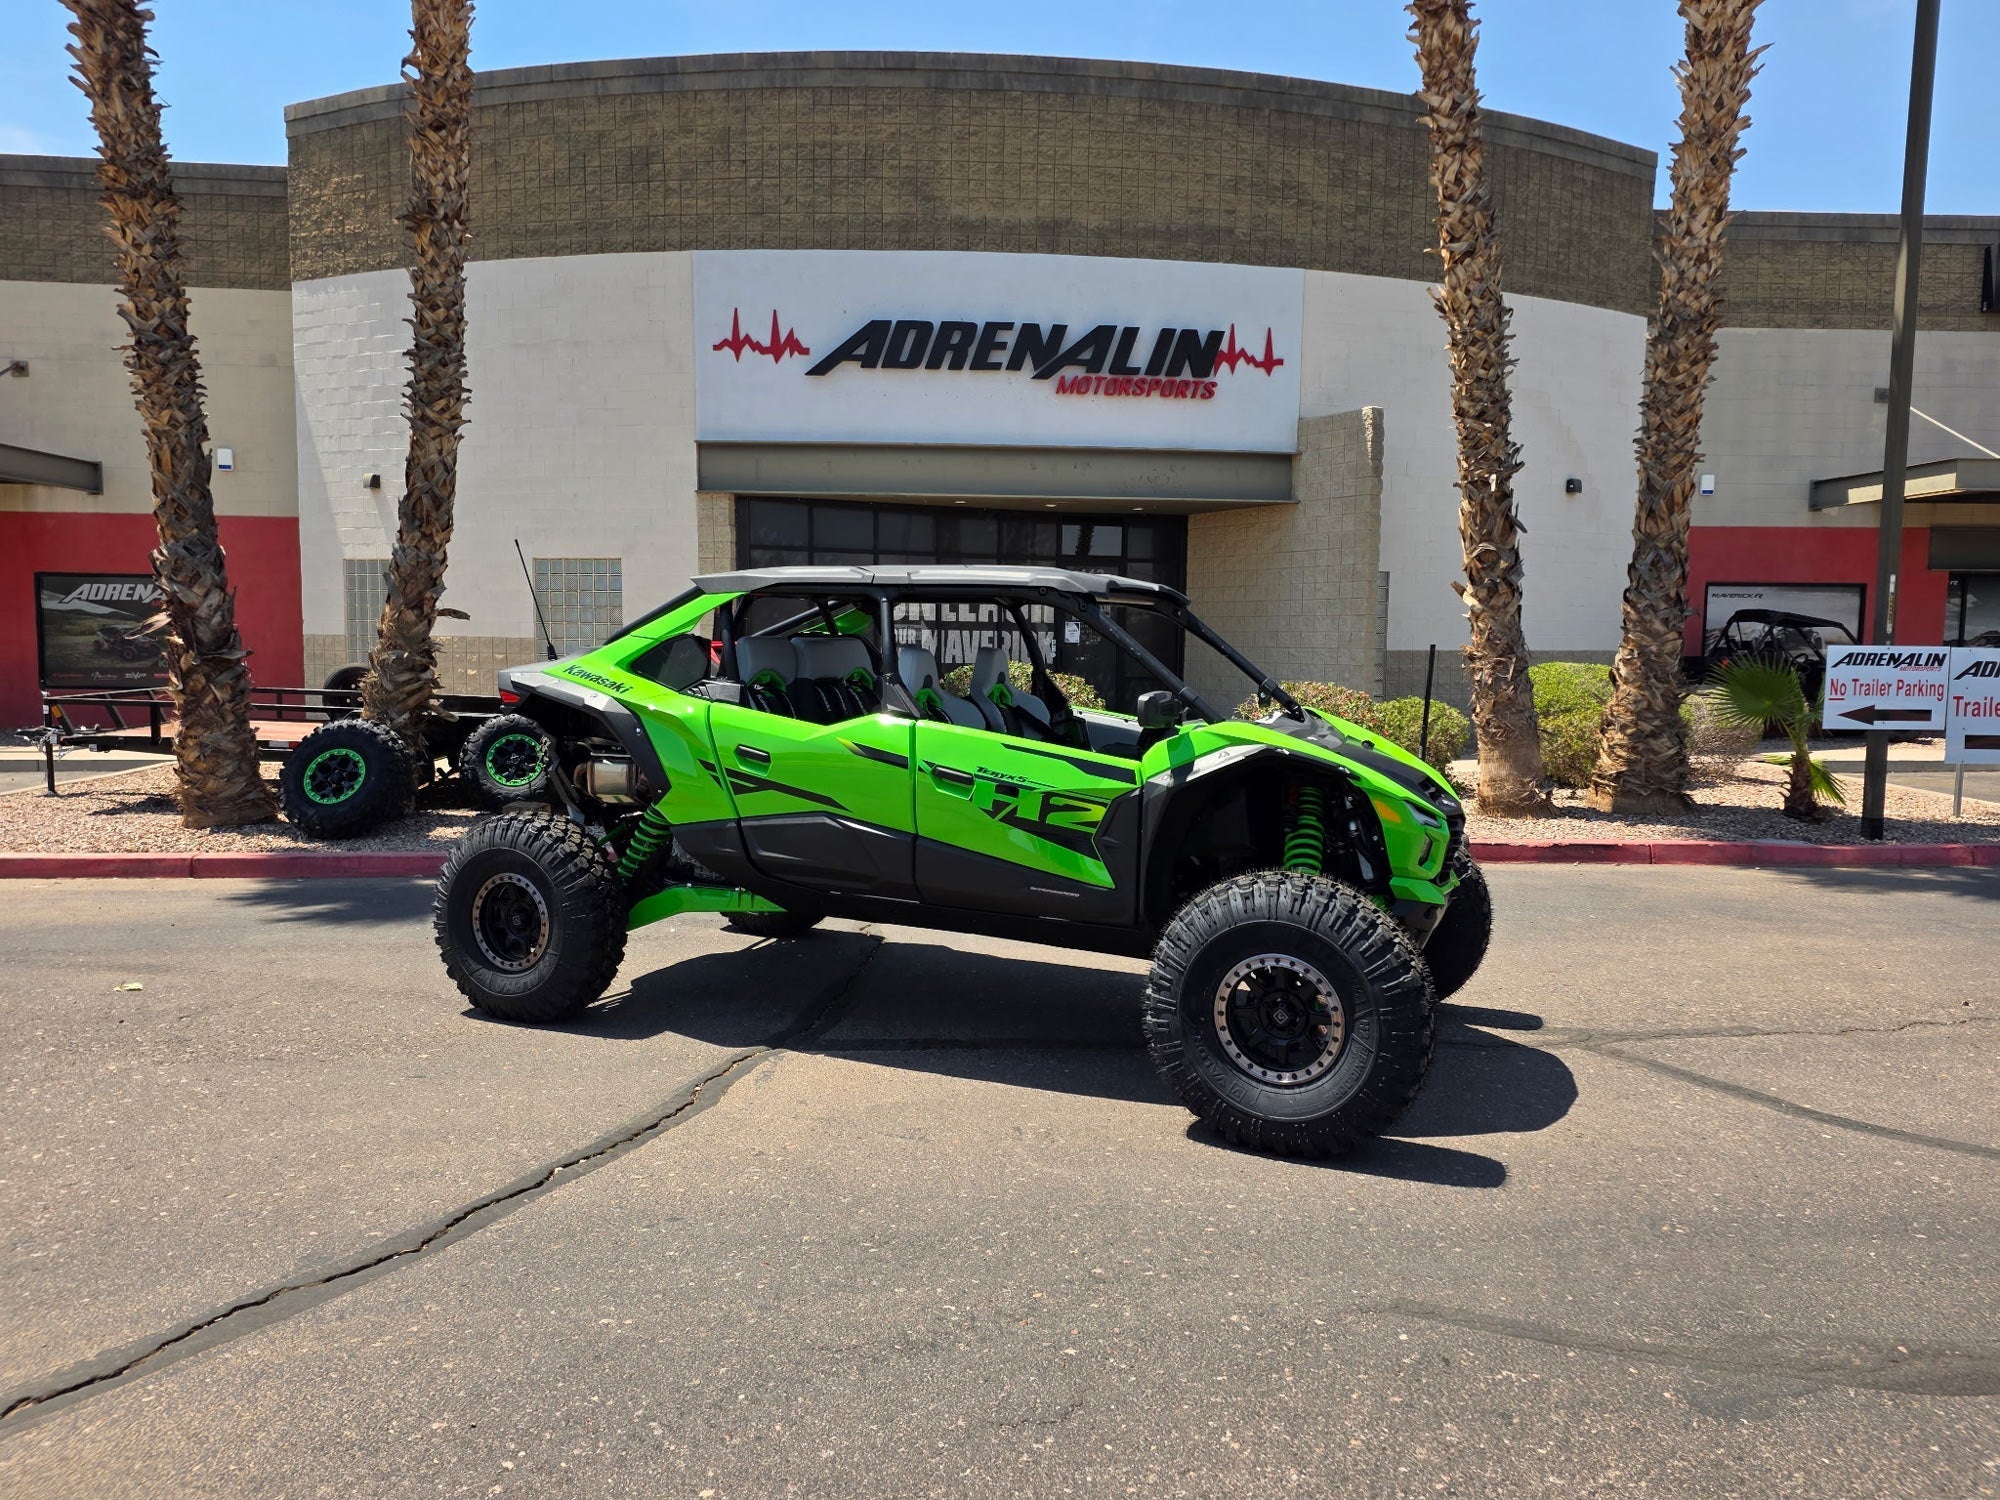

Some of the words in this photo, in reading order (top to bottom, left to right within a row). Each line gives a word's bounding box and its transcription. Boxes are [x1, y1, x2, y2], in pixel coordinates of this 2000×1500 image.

[805, 319, 1226, 380] ADRENALIN
[1056, 374, 1218, 400] MOTORSPORTS
[1831, 652, 1947, 669] ADRENALIN
[562, 664, 634, 694] Kawasaki
[1829, 678, 1847, 697] No
[1852, 678, 1892, 697] Trailer
[1895, 679, 1945, 702] Parking
[972, 778, 1107, 834] H2
